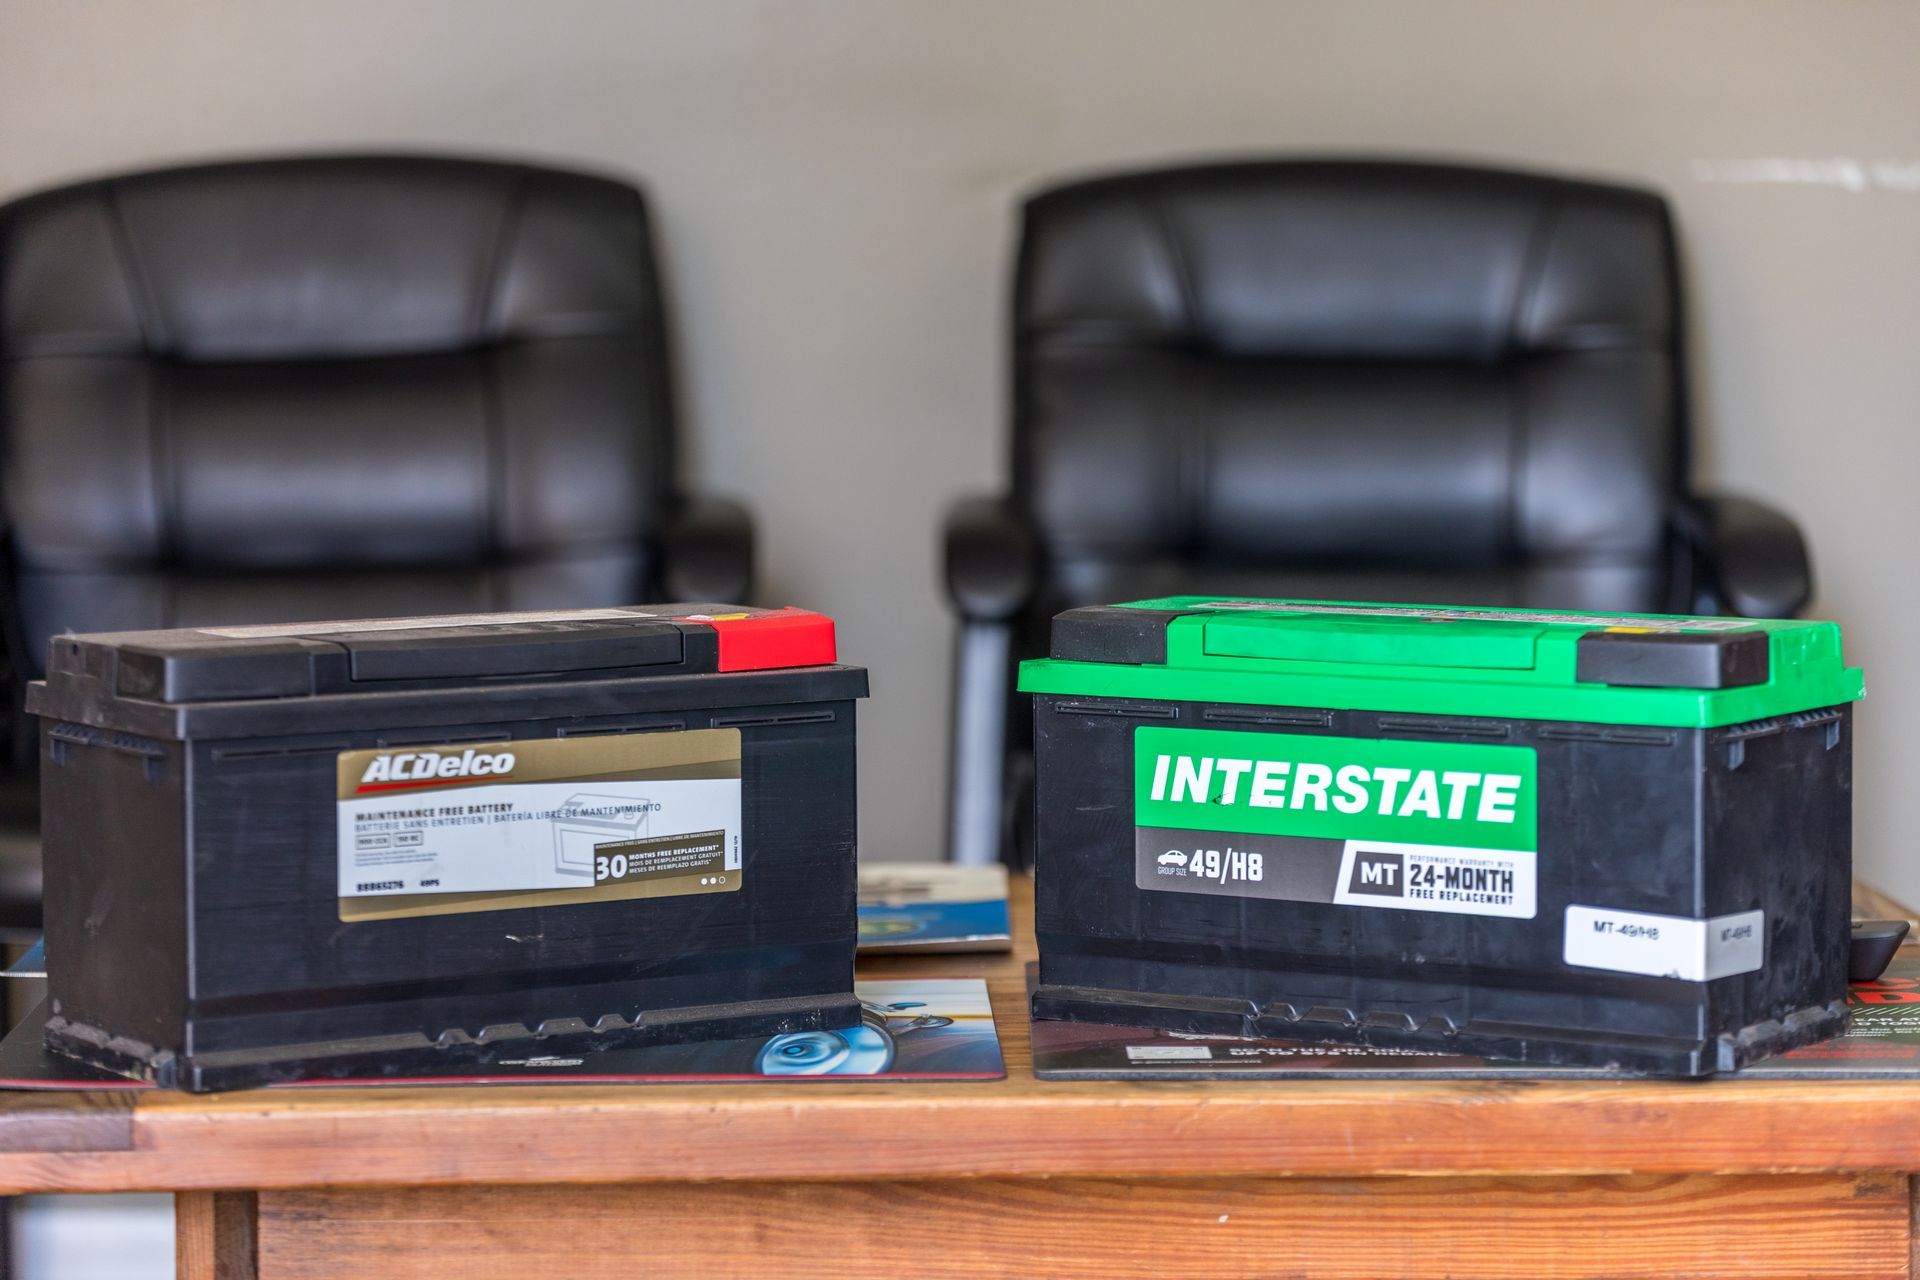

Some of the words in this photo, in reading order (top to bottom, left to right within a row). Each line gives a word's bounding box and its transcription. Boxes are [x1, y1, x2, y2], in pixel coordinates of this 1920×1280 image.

[361, 749, 515, 783] ACDelco
[1150, 754, 1522, 824] INTERSTATE
[355, 807, 435, 822] MAINTENANCE
[439, 805, 464, 817] FREE
[468, 803, 514, 815] BATTERY
[355, 821, 401, 833] BATTERIE
[404, 818, 428, 829] SANS
[431, 815, 485, 828] ENTRETIEN
[494, 810, 534, 823] BATERÍA
[536, 809, 562, 820] LIBRE
[565, 808, 578, 818] DE
[580, 803, 662, 818] MANTENIMIENTO
[629, 851, 656, 860] MONTHS
[657, 849, 672, 858] FREE
[629, 860, 644, 868] MOIS
[654, 854, 697, 864] REMPLACEMENT
[1189, 848, 1264, 884] 49/H8
[596, 854, 628, 880] 30
[629, 866, 647, 874] MESES
[657, 861, 689, 871] REEMPLAZO
[1157, 866, 1175, 875] GROUP
[1175, 867, 1187, 876] SIZE
[1361, 862, 1398, 886] MT
[1410, 864, 1513, 893] 24-MONTH
[1410, 888, 1434, 899] FREE
[1440, 890, 1513, 905] REPLACEMENT
